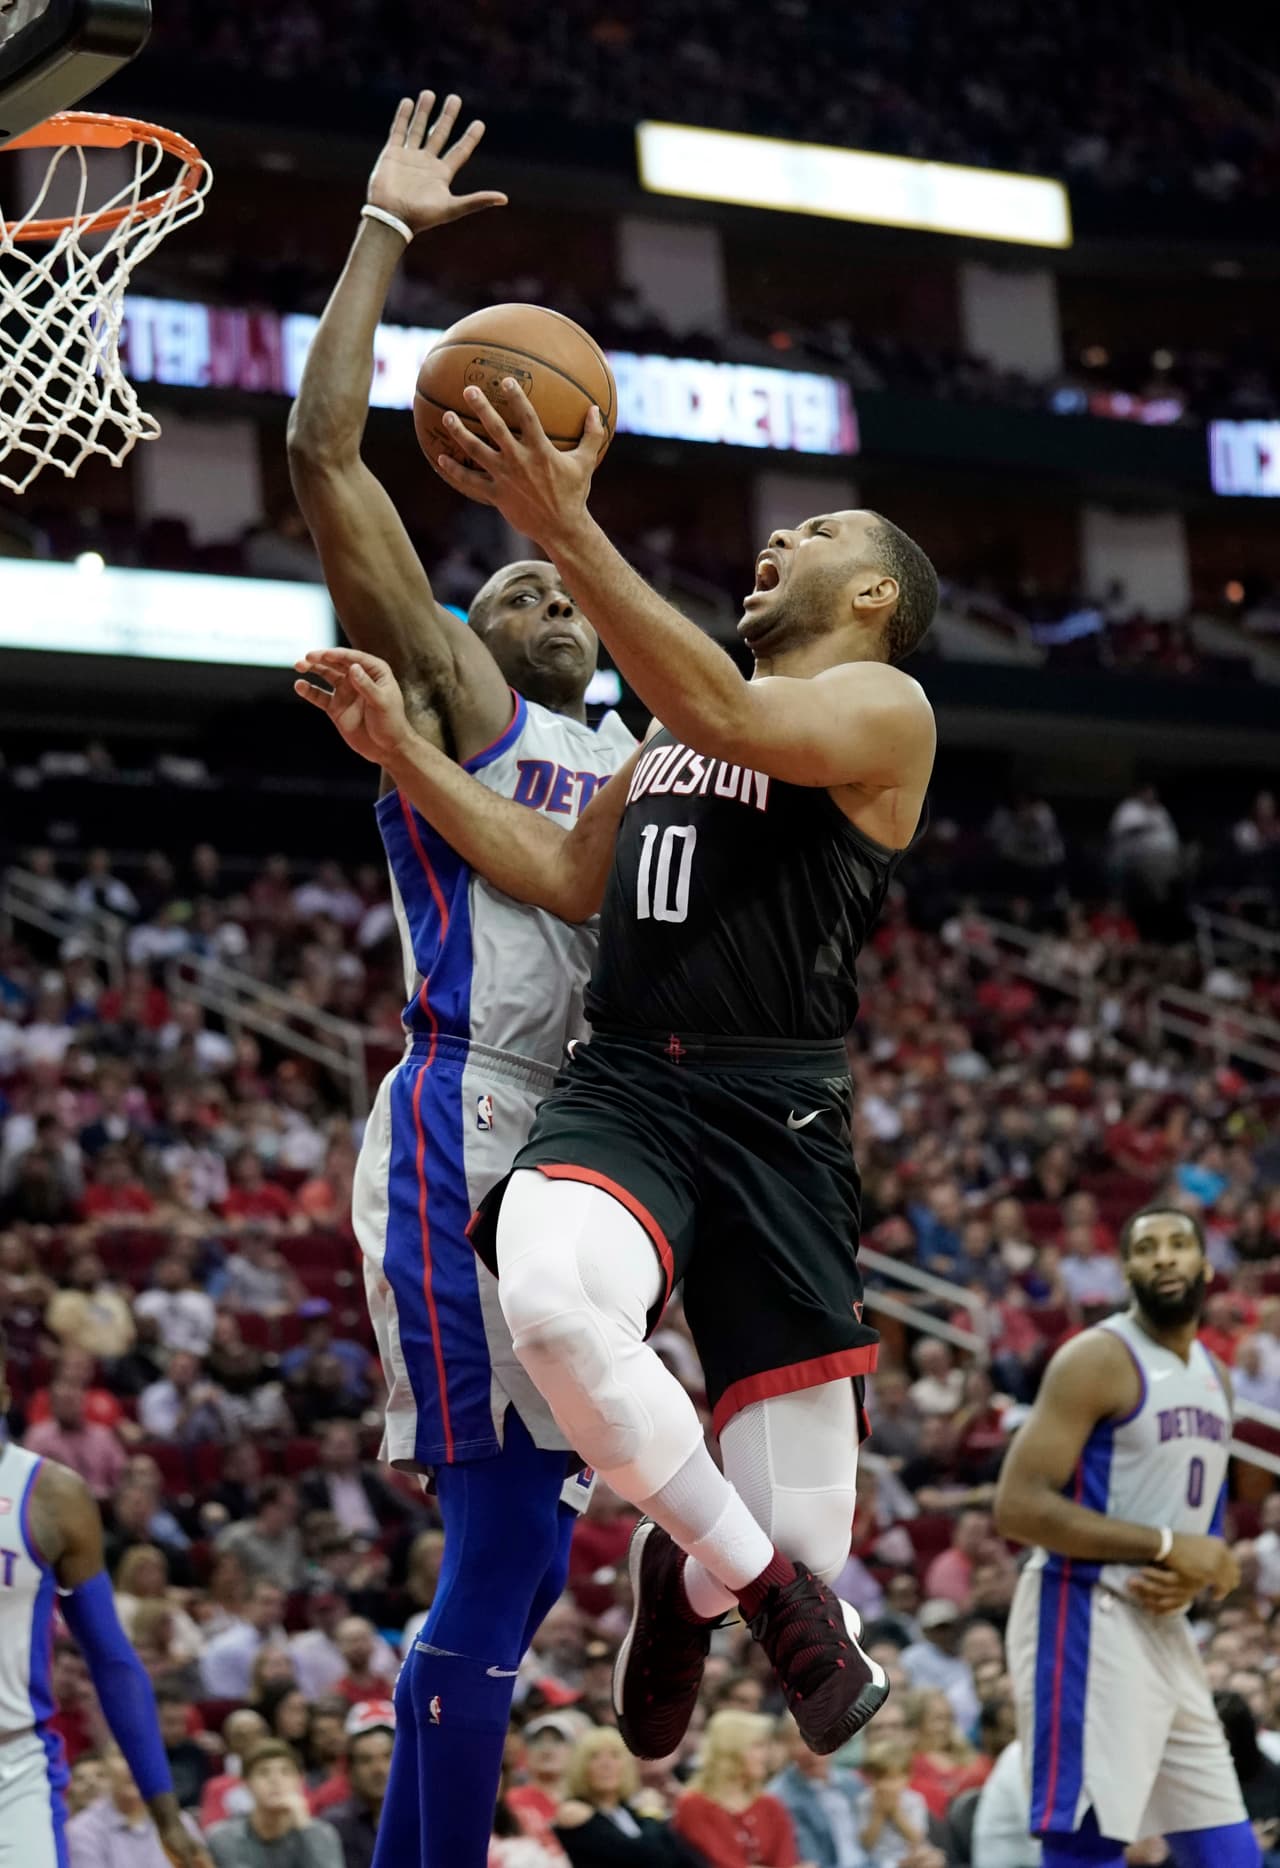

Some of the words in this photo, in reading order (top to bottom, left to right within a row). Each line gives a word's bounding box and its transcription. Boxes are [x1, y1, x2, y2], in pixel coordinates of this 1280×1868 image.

[512, 759, 614, 817] DET
[635, 824, 697, 923] 10
[1187, 1456, 1205, 1508] 0
